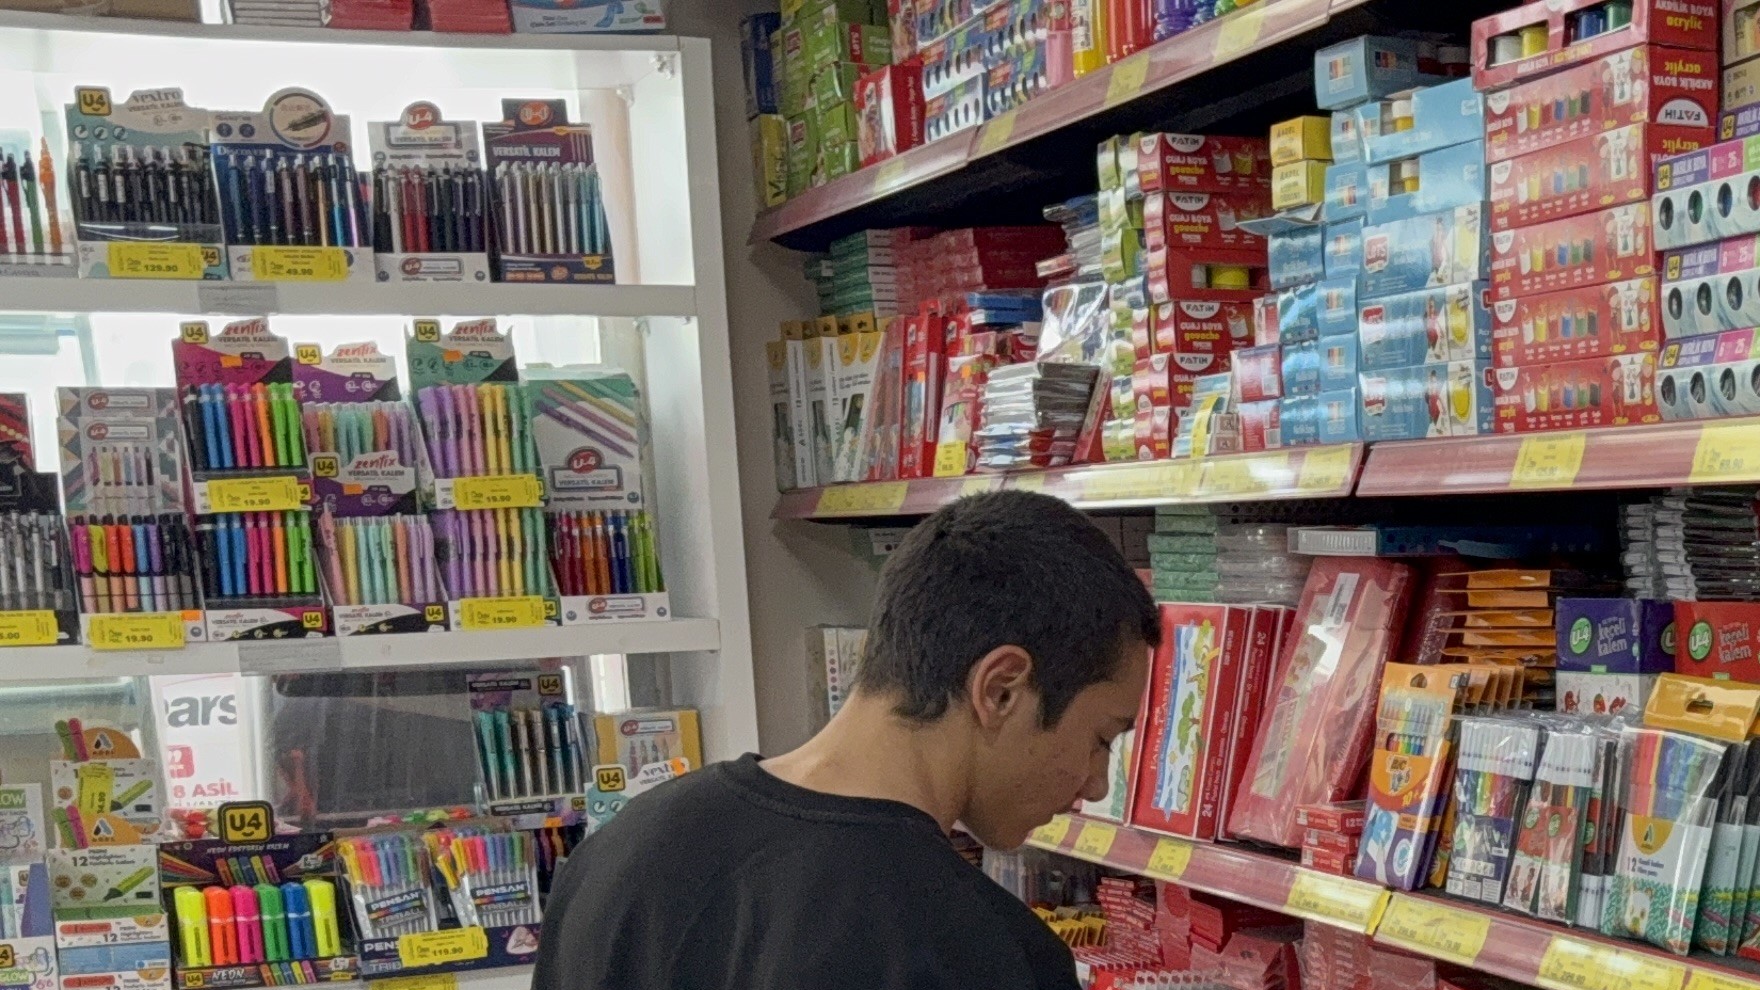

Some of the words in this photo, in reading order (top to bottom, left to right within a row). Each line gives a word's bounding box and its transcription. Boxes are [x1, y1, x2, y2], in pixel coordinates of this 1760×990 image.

[230, 814, 262, 832] U4
[364, 940, 401, 953] PENS
[369, 960, 401, 973] TRIB
